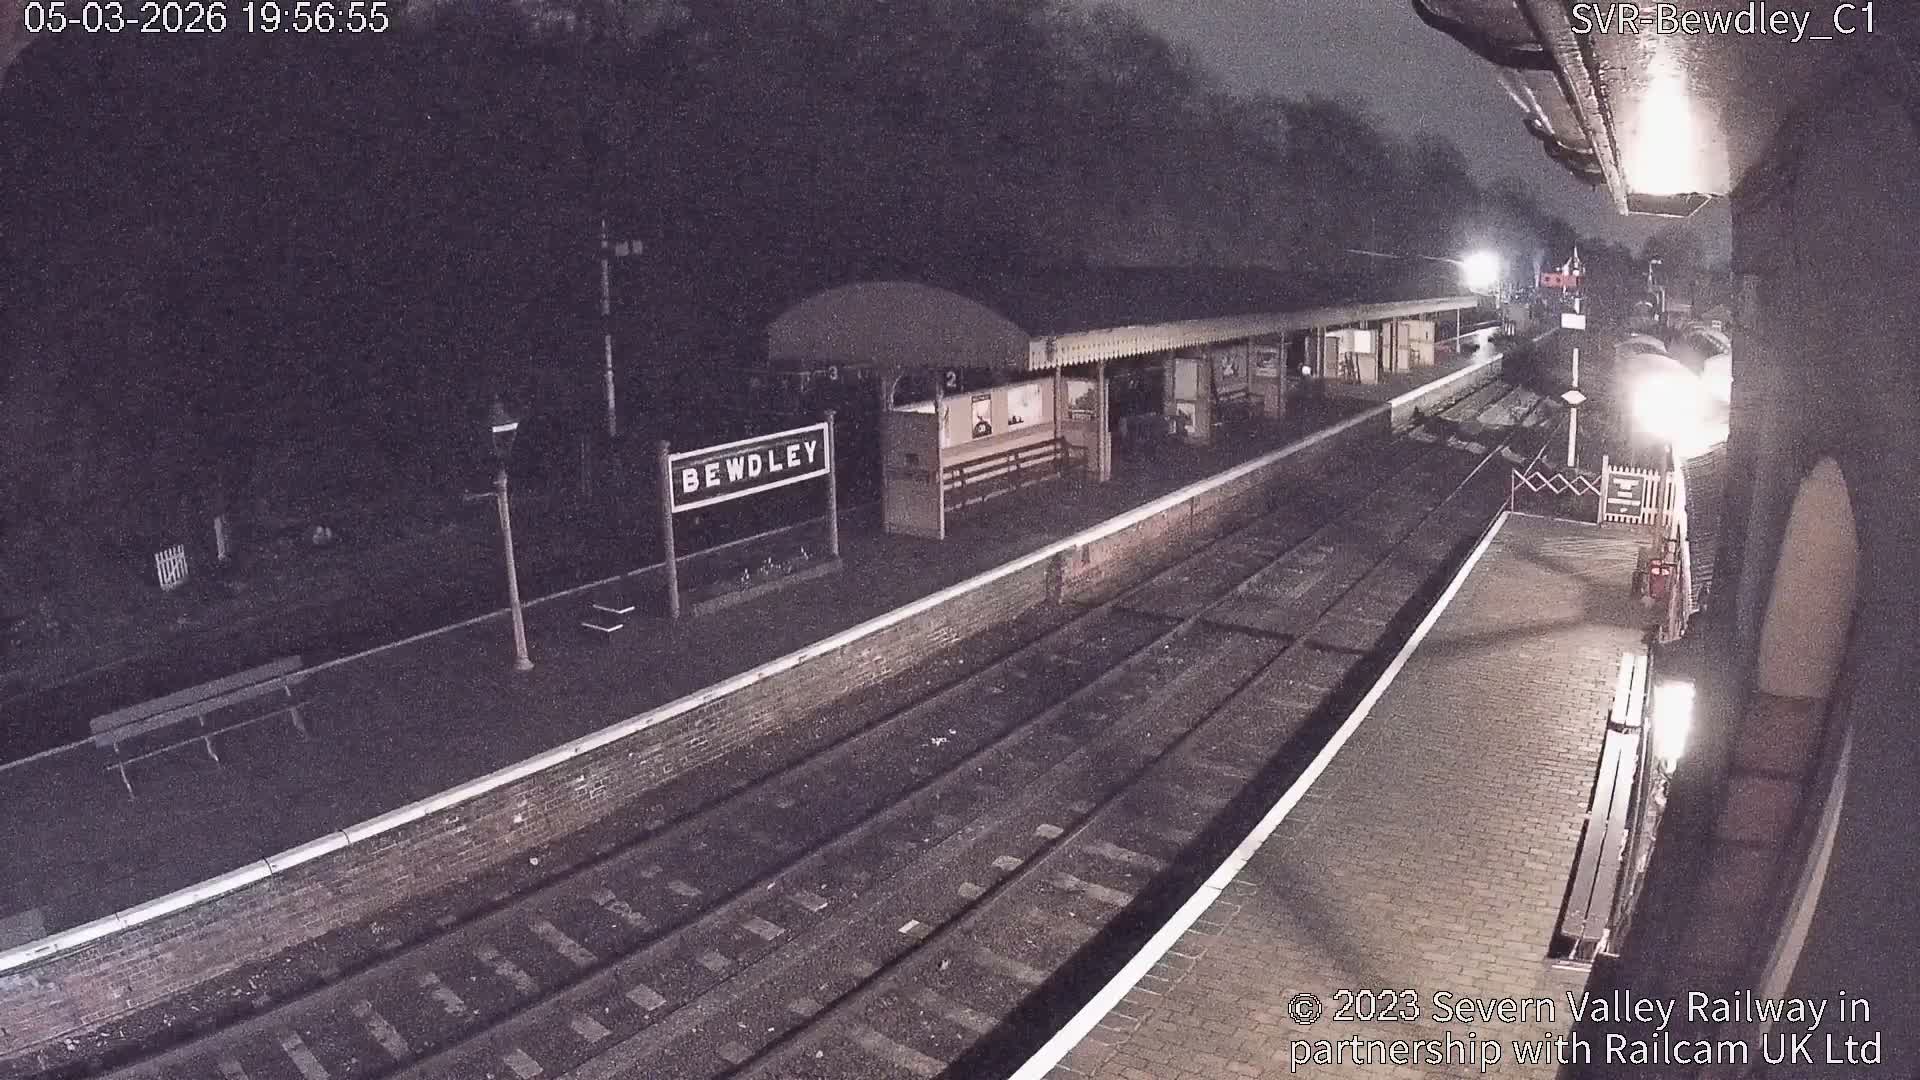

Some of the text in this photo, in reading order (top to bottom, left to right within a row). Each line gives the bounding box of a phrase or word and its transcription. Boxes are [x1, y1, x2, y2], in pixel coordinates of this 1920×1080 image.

[828, 365, 838, 381] 3
[946, 371, 957, 388] 2
[682, 440, 816, 493] BEWDLEY
